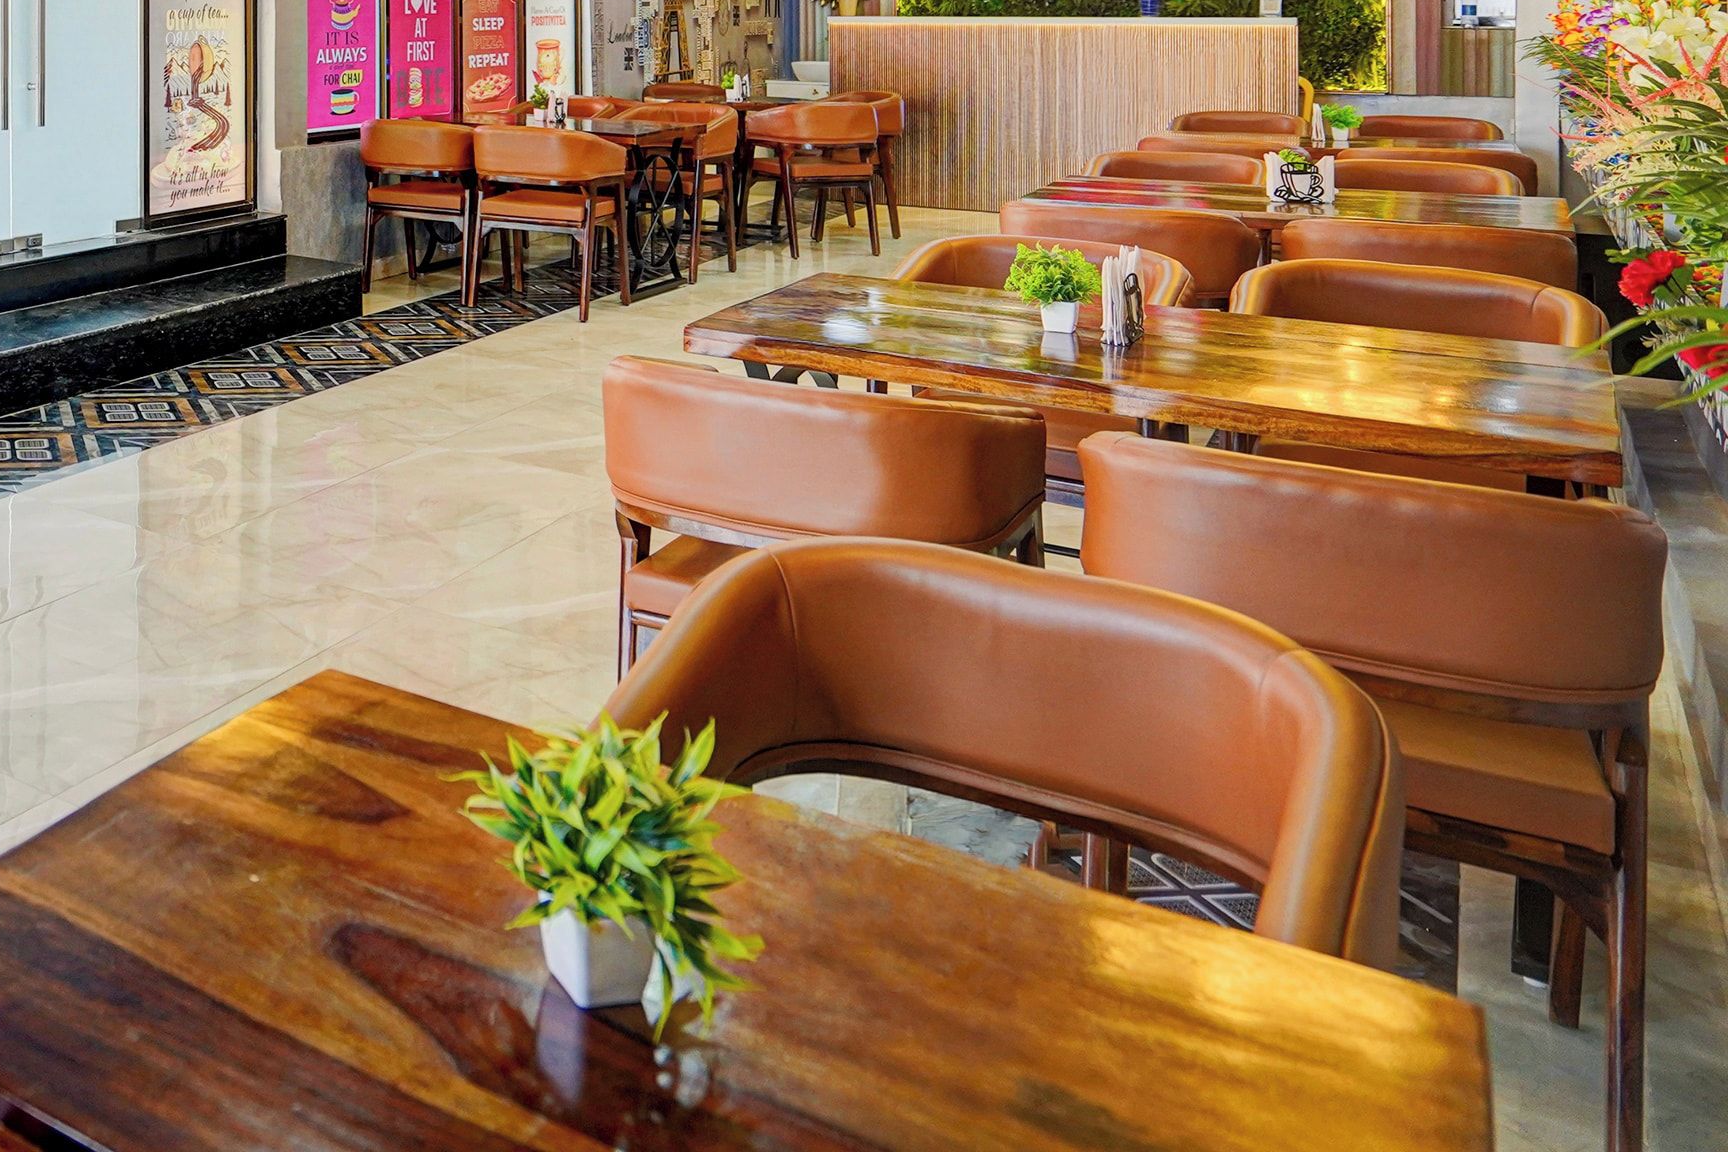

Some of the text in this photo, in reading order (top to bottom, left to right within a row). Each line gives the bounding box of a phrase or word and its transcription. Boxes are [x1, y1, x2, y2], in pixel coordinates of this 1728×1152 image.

[414, 17, 428, 38] AT
[472, 17, 505, 32] SLEEP
[325, 30, 359, 46] IT IS
[316, 47, 368, 65] ALWAYS
[406, 40, 436, 62] FIRST
[468, 52, 510, 69] REPEAT
[323, 72, 361, 87] FOR CHAI
